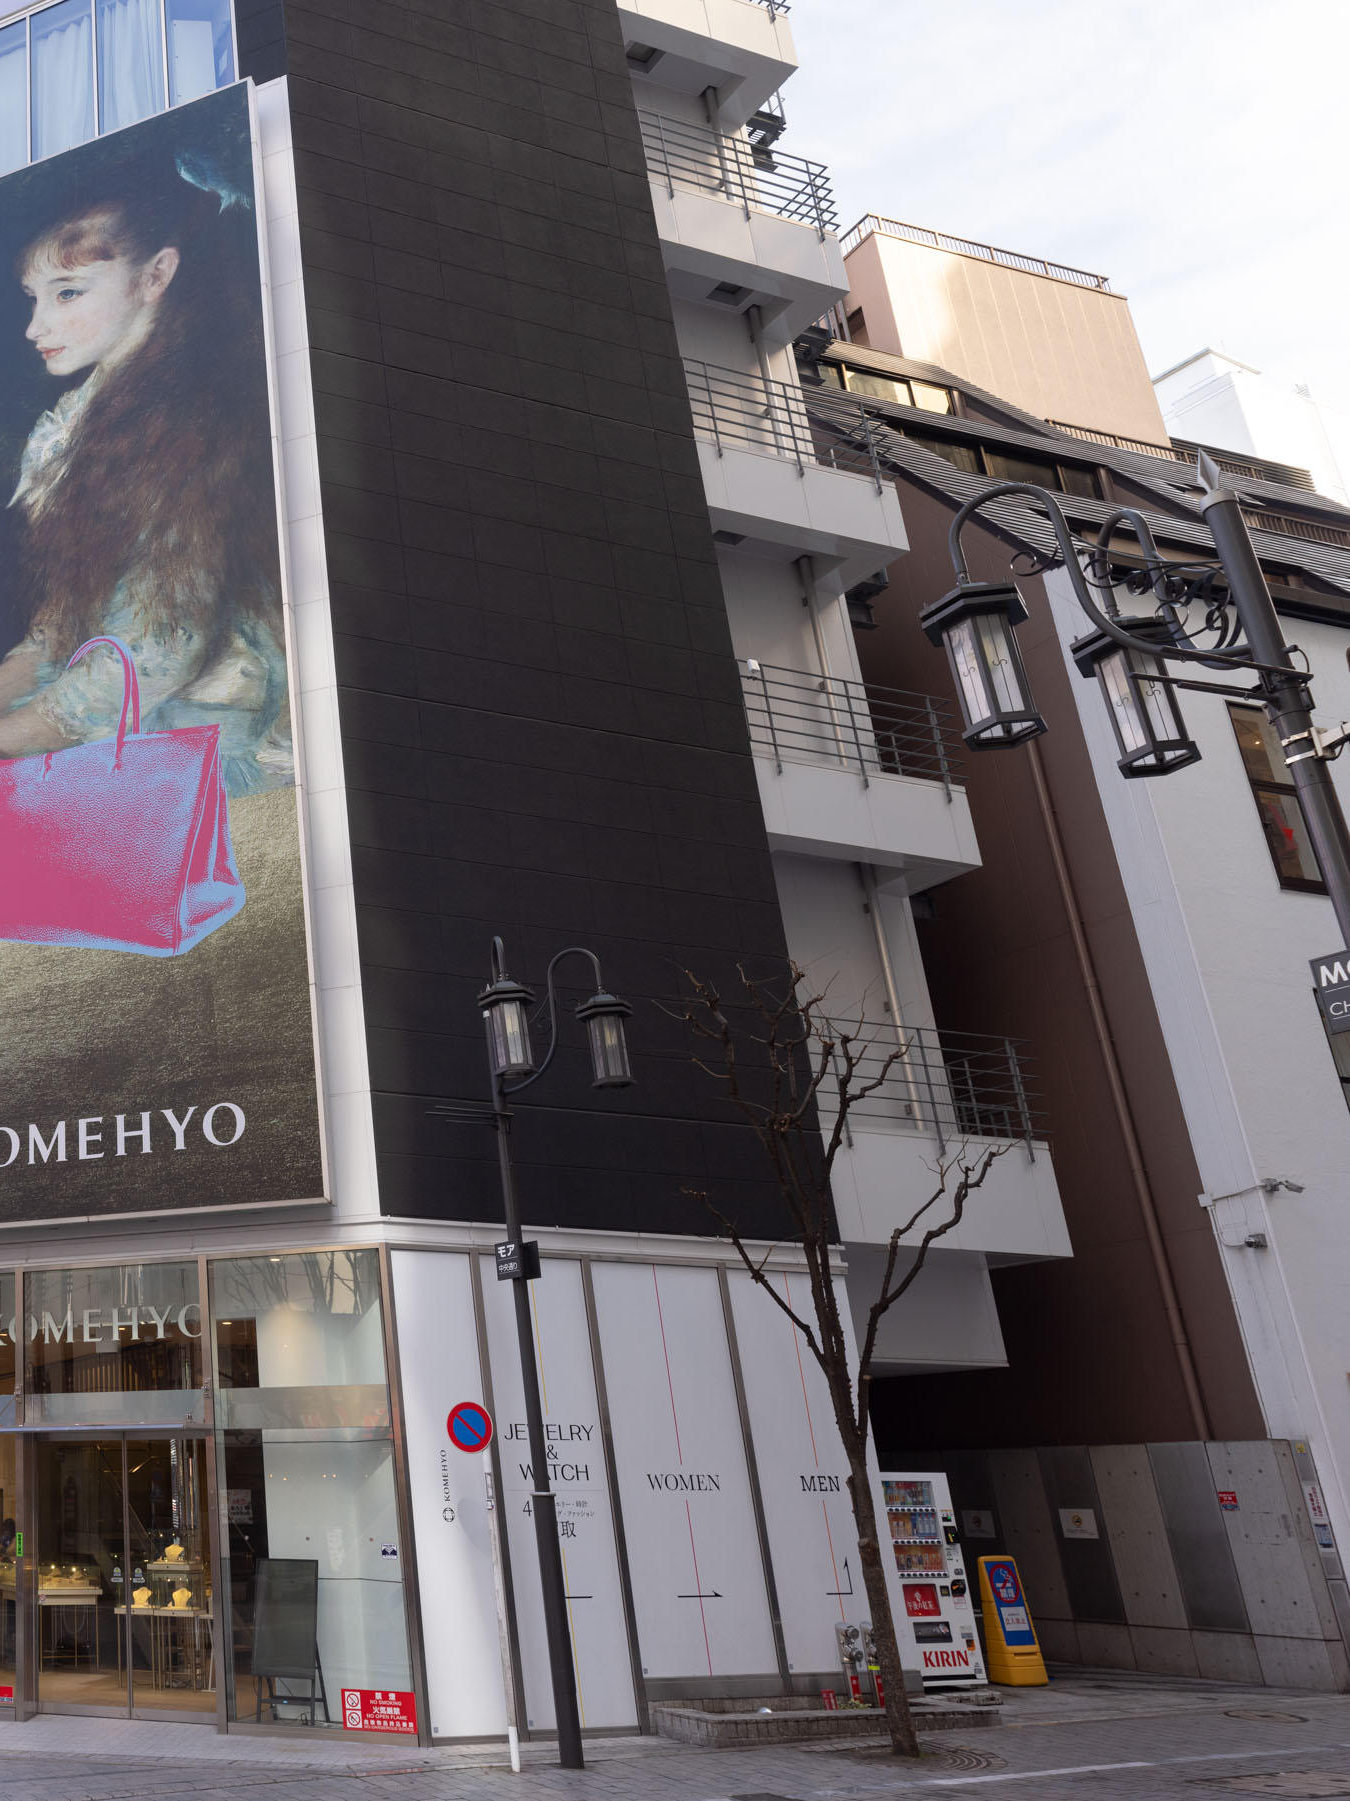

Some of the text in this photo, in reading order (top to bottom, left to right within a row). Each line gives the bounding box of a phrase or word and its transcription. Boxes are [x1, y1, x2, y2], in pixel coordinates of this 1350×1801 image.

[1319, 961, 1350, 987] M
[497, 1243, 515, 1258] モア
[498, 1261, 518, 1272] 中央通り
[504, 1423, 594, 1441] JEELRY
[546, 1444, 559, 1460] &
[440, 1449, 451, 1502] KOMEHYO
[519, 1463, 590, 1481] WTCH
[646, 1473, 721, 1492] WOMEN
[800, 1474, 841, 1493] MEN
[558, 1521, 577, 1538] 取
[922, 1650, 970, 1668] KIRIN
[372, 1706, 401, 1715] 火気厳禁
